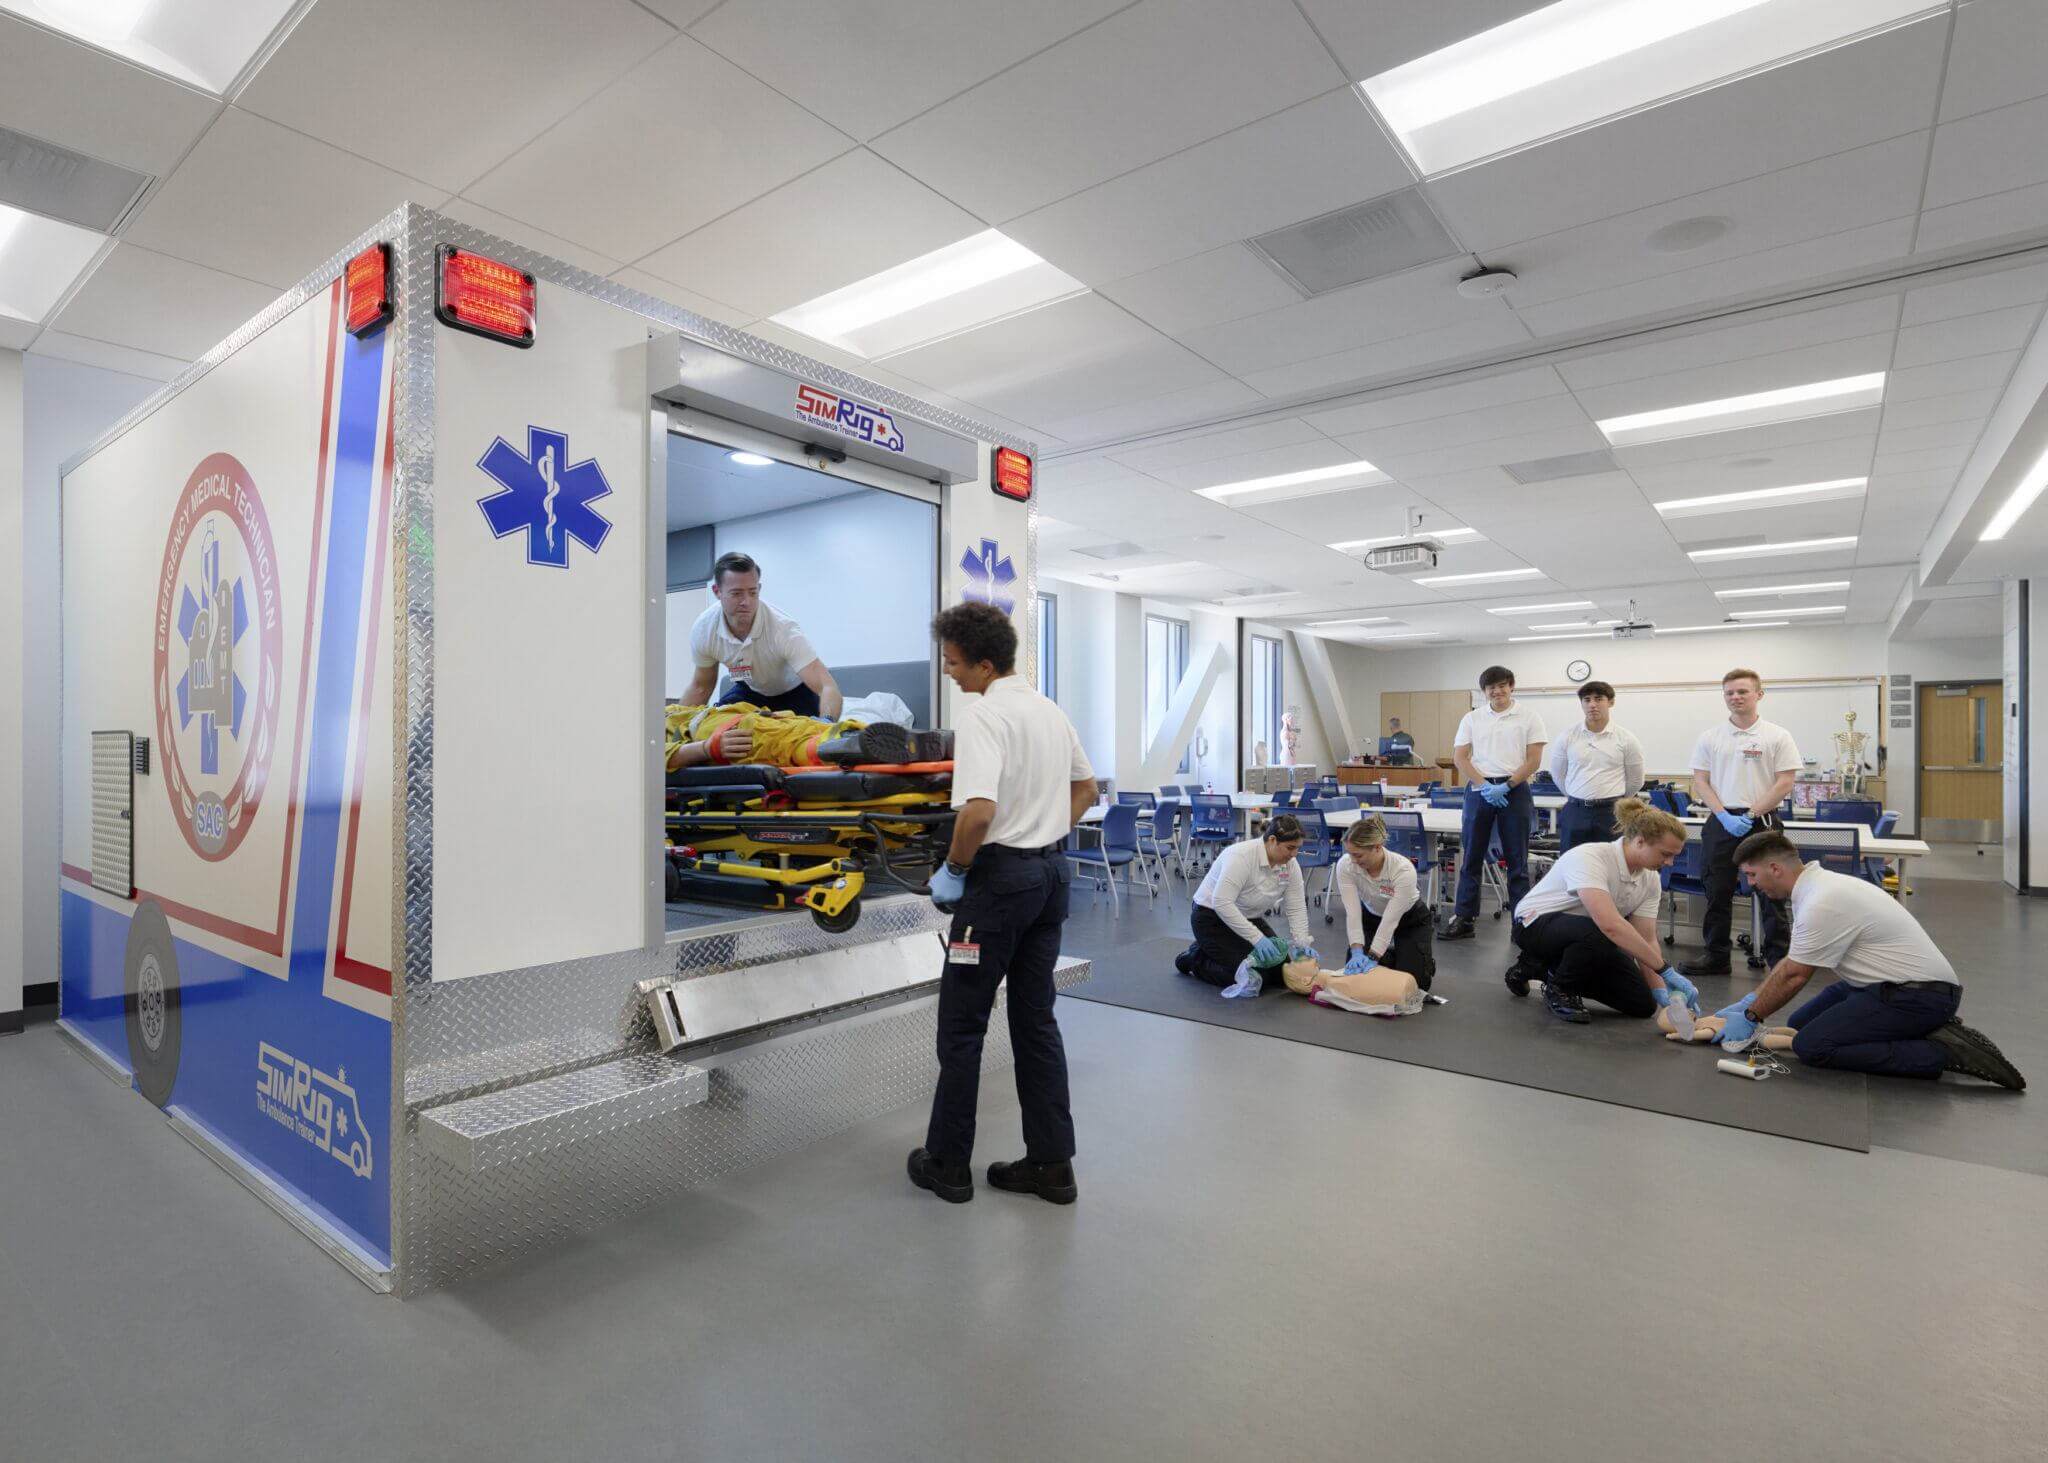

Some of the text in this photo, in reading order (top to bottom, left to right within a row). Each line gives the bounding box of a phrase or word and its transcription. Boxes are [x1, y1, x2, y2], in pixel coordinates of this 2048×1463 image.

[795, 410, 807, 421] The
[158, 474, 275, 651] EMERGENCY MEDICAL TECHNICIAN
[196, 801, 223, 838] SAC
